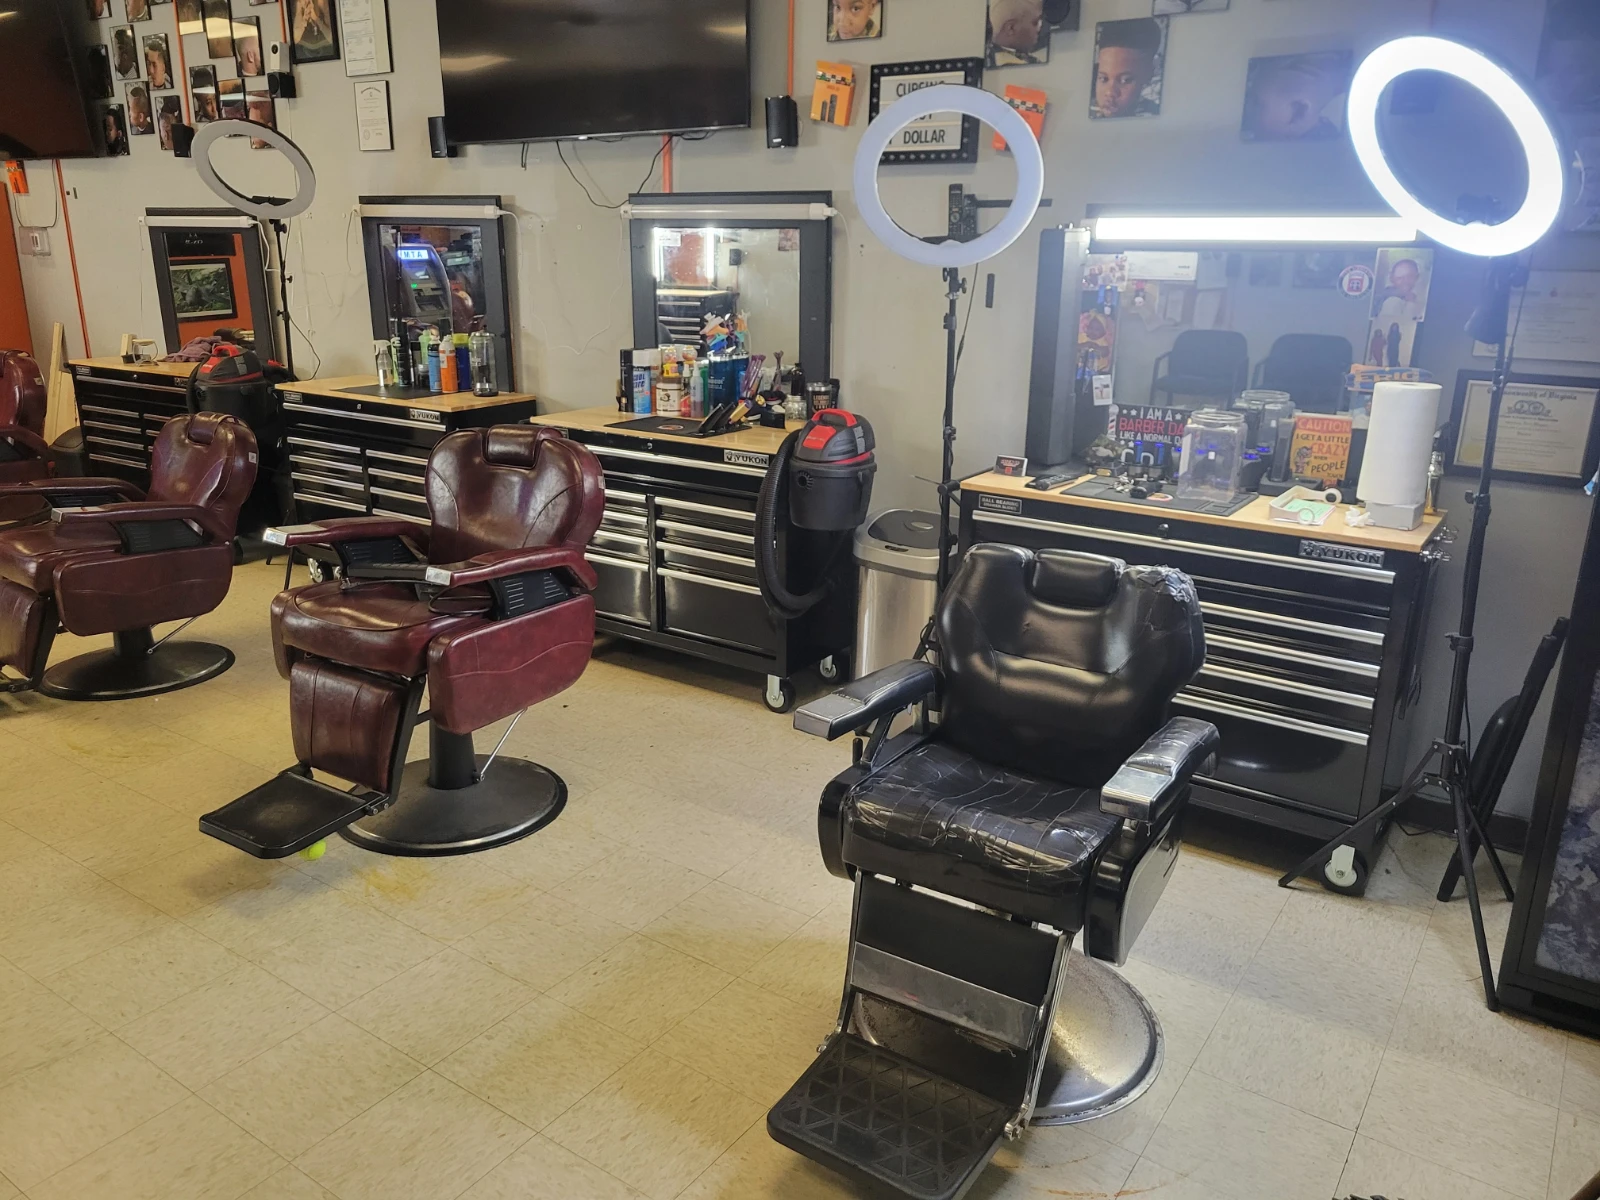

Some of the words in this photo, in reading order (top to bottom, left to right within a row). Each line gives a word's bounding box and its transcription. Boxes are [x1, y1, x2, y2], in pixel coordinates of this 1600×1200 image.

[903, 129, 946, 145] DOLLAR
[1140, 407, 1144, 419] I
[1146, 407, 1162, 420] AM
[1165, 409, 1173, 421] A
[1119, 417, 1165, 434] BARBER
[1168, 422, 1185, 436] DA
[1299, 419, 1350, 433] CAUTION
[1120, 430, 1136, 440] LIKE
[1136, 432, 1142, 441] A
[1301, 433, 1316, 441] GET
[1324, 435, 1349, 444] LITTLE
[1312, 442, 1348, 456] CRAZY
[735, 454, 768, 465] YUKON
[1311, 460, 1346, 473] PEOPLE
[1320, 547, 1380, 564] YUKON
